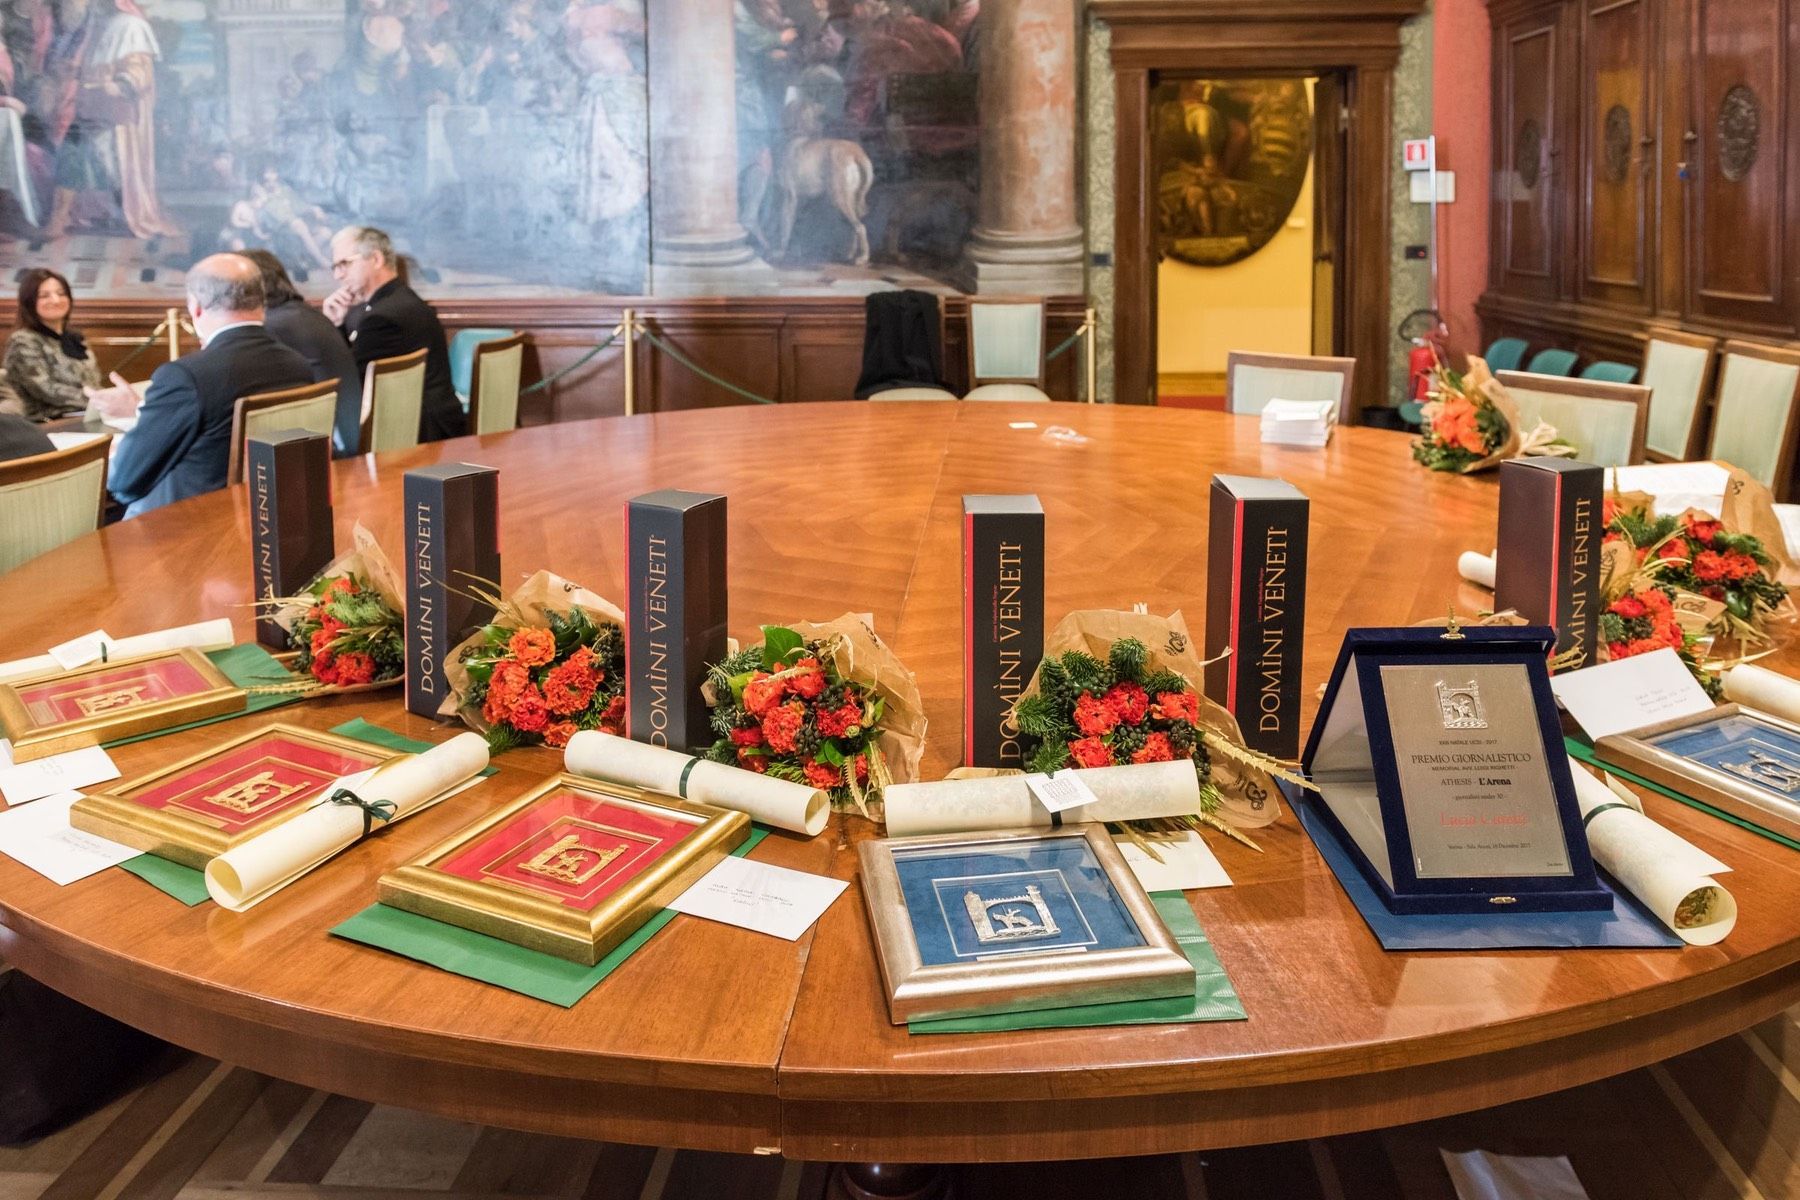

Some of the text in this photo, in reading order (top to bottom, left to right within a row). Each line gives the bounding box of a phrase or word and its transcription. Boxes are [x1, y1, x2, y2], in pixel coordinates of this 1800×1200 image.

[257, 464, 270, 538] VENETI
[1573, 498, 1591, 586] VENETI
[417, 503, 432, 588] VENETI
[649, 536, 667, 633] VENETI
[1263, 527, 1289, 623] VENETI
[1000, 542, 1022, 642] VENETI
[1411, 753, 1532, 764] PREMIO GIORNALISTICO
[1440, 778, 1472, 786] ATHESIS
[1479, 778, 1512, 786] L'Arena
